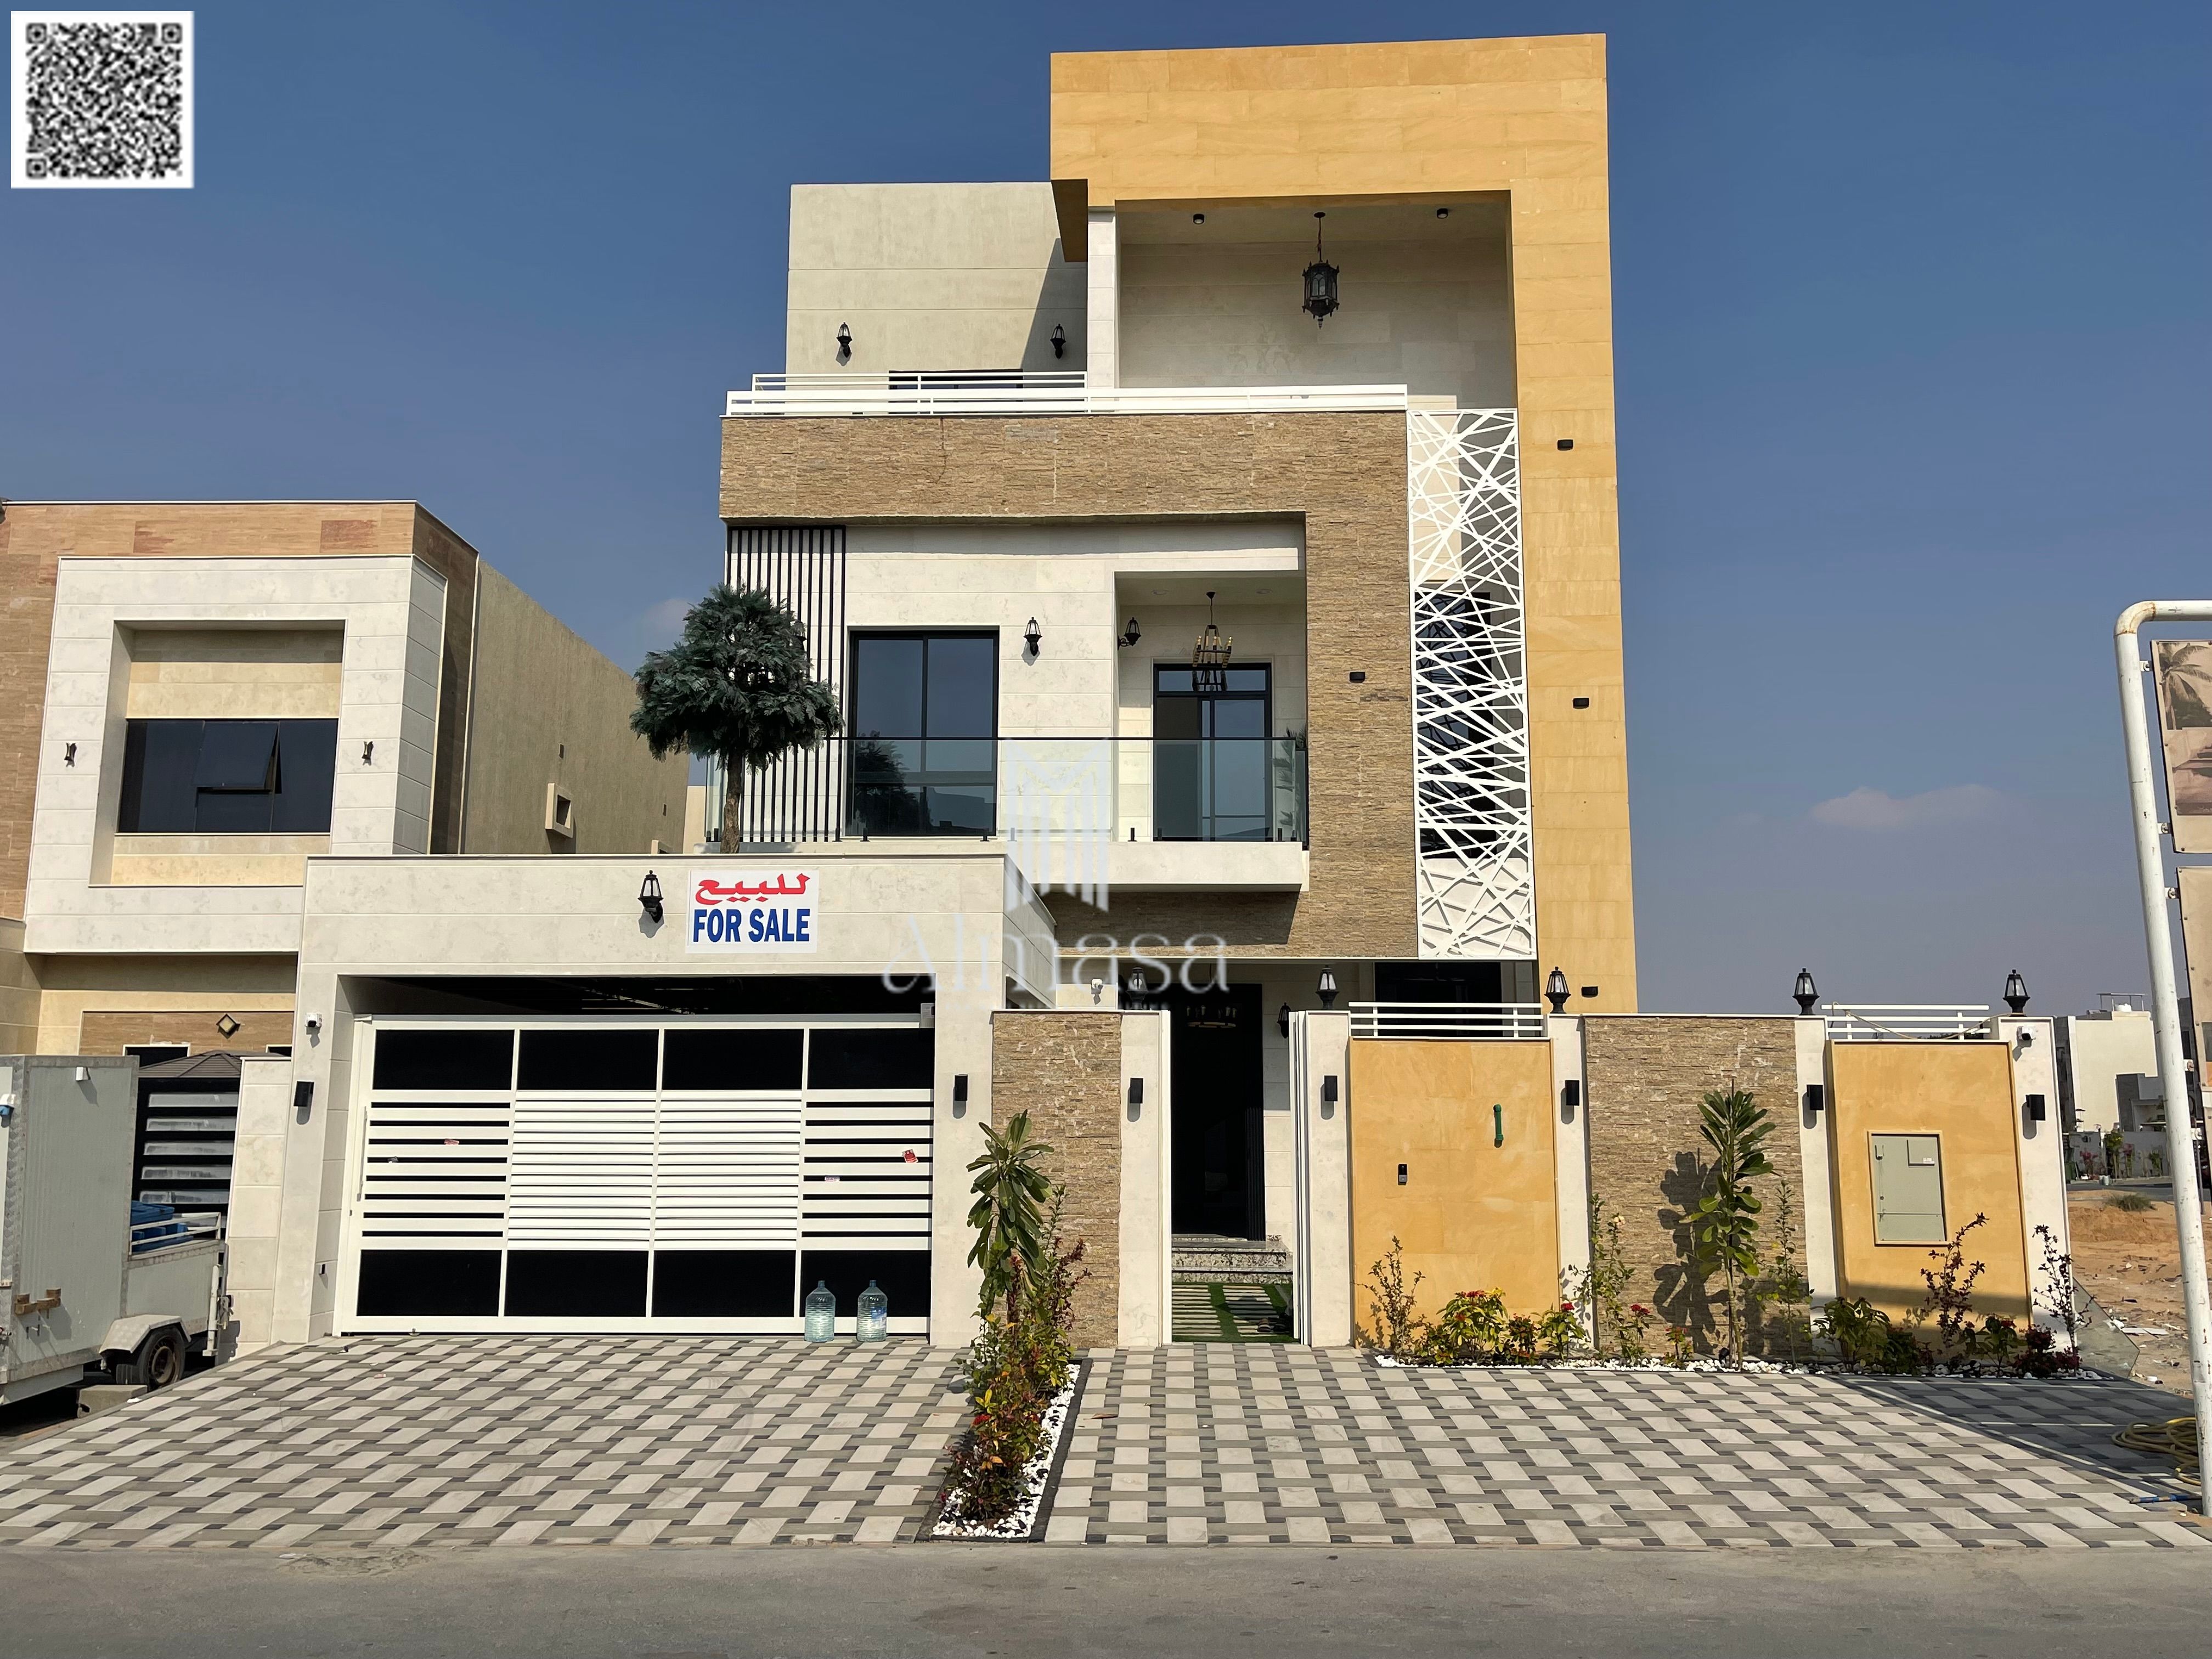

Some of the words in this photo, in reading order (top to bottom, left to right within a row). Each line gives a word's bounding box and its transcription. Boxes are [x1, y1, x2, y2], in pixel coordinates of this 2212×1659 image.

[695, 873, 810, 905] للبيع
[693, 909, 742, 943] FOR
[748, 909, 811, 943] SALE
